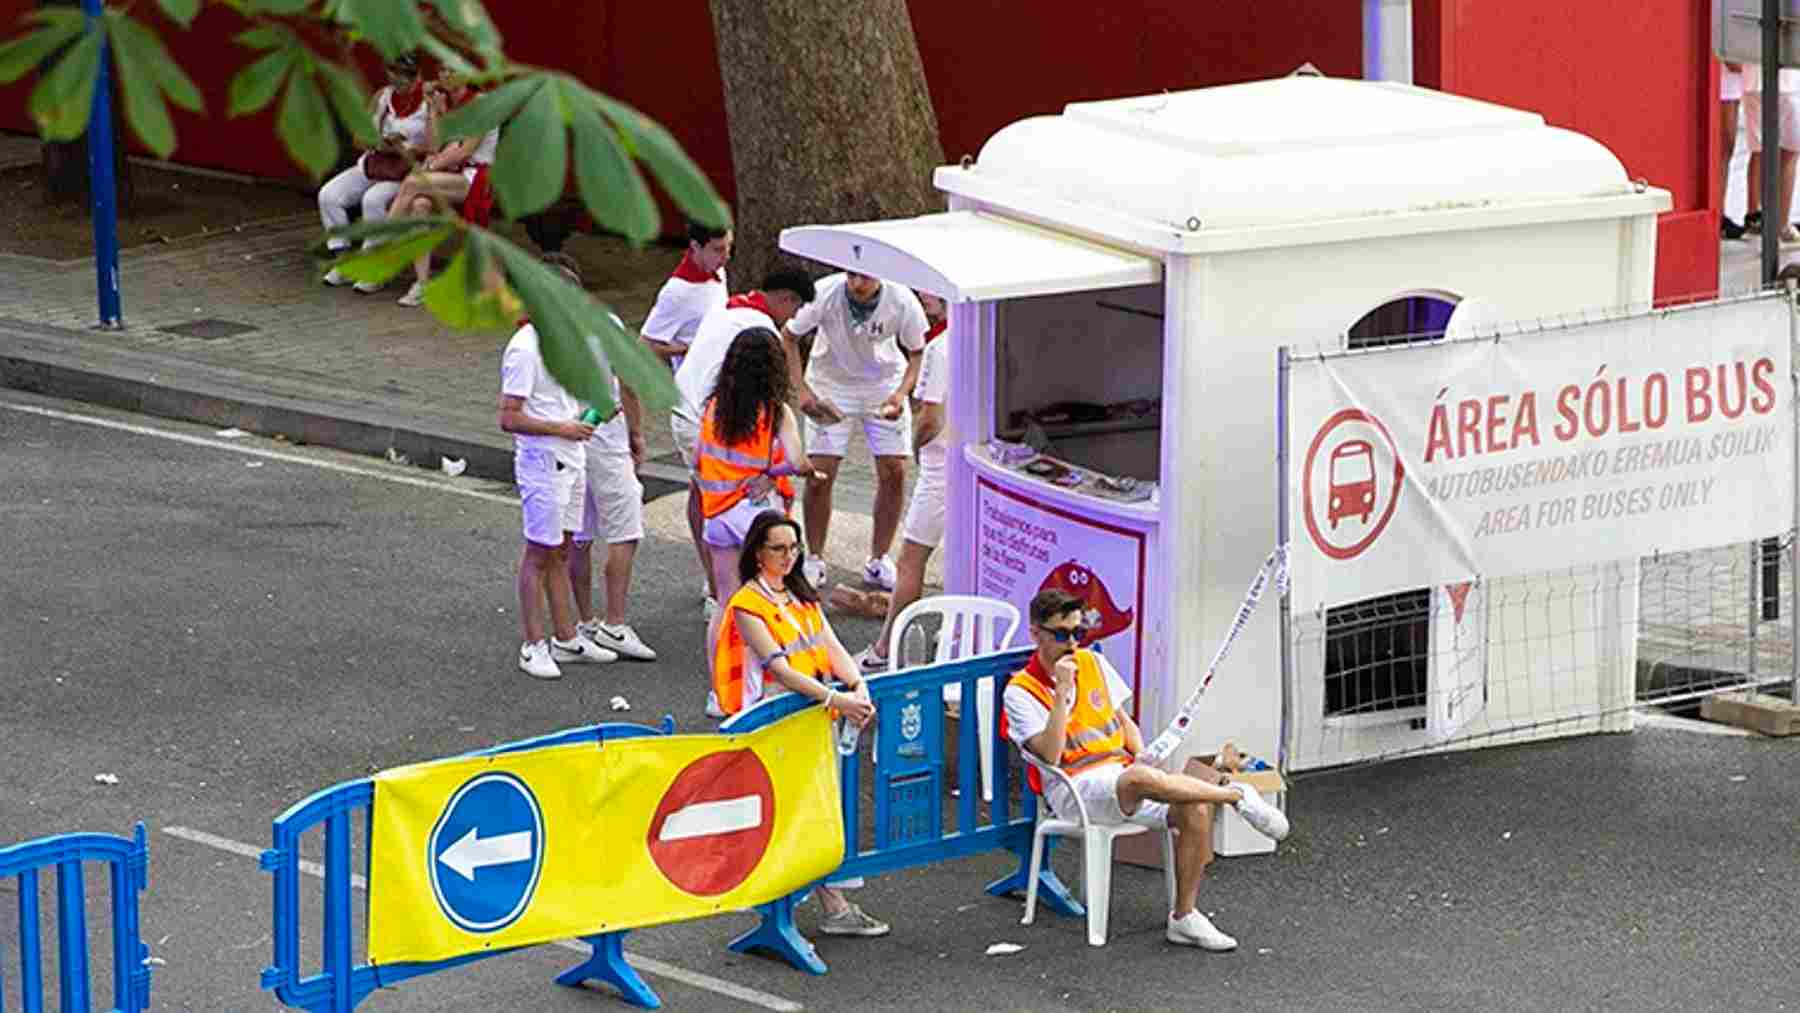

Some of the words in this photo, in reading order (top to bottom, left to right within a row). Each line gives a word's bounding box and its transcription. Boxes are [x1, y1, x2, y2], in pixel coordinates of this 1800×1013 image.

[1424, 387, 1540, 463] ÁREA
[1553, 364, 1669, 442] SÓLO
[1684, 357, 1776, 424] BUS
[1612, 438, 1701, 475] EREMUA
[1474, 507, 1530, 539] AREA
[1536, 499, 1576, 529] FOR
[1581, 488, 1651, 522] BUSES
[1660, 477, 1714, 511] ONLY
